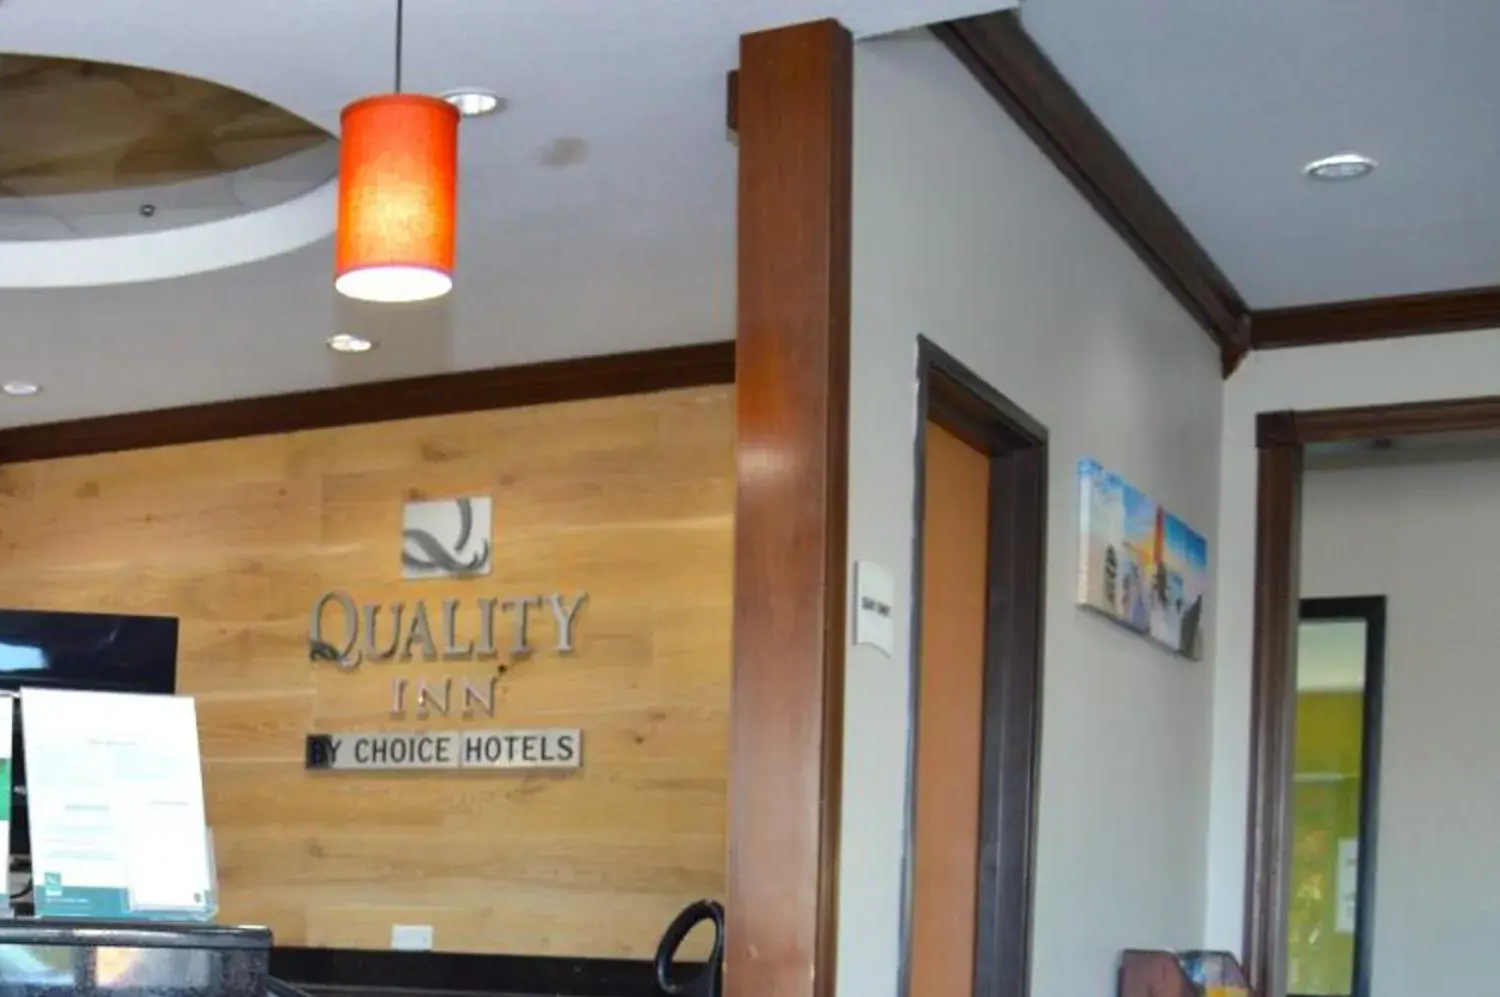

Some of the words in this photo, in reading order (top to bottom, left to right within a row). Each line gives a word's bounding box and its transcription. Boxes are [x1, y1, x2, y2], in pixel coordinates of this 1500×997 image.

[309, 591, 590, 671] QUALITY
[389, 676, 498, 720] INN
[354, 736, 451, 765] CHOICE
[465, 734, 575, 764] HOTELS
